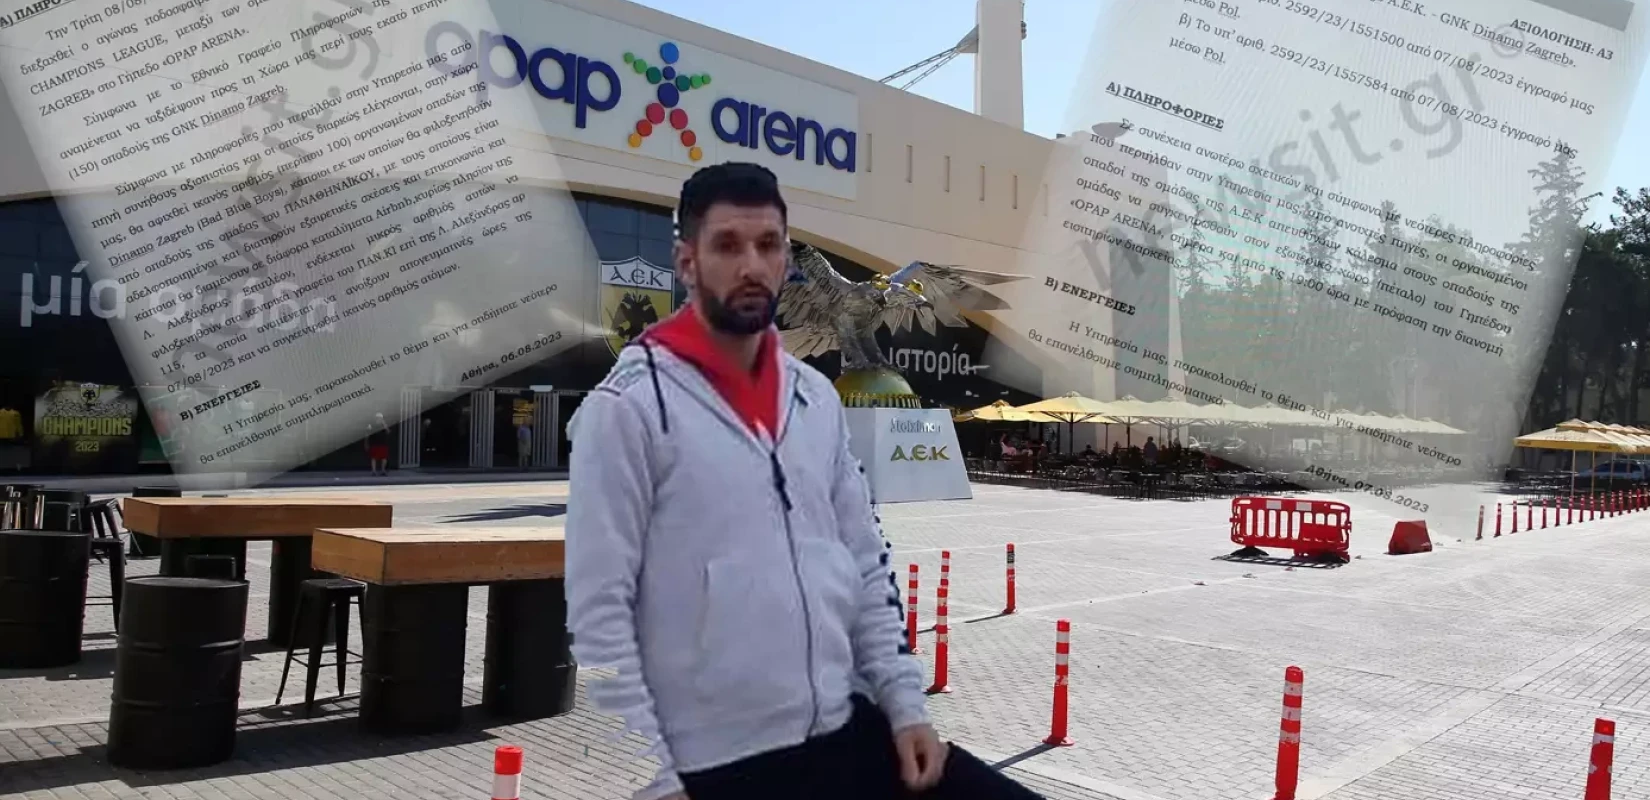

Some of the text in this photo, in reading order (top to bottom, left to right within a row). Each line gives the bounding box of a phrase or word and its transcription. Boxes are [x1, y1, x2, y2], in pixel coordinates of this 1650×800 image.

[1168, 35, 1226, 63] μέσω Pol.
[1218, 1, 1241, 17] Pol.
[1439, 12, 1470, 30] GNK
[1472, 22, 1524, 48] Dinamo
[1509, 18, 1613, 60] ΑΞΙΟΛΟΓΗΣΗ: Α3
[29, 5, 240, 95] CHAMPIONS LEAGUE, μεταξύ των
[59, 8, 408, 161] αναμένεται να ταξιδέψουν προς τη Χώρα μας περί τους εκατό
[82, 5, 364, 128] Σύμφωνα με το Εθνικό Γραφείο Πληροφοριών
[96, 79, 116, 92] στο
[116, 60, 160, 84] Γήπεδο
[1178, 12, 1192, 28] β)
[1194, 17, 1211, 32] Το
[1235, 33, 1266, 52] αριθ.
[1269, 44, 1388, 93] 2592/23/1557584
[1390, 85, 1416, 101] από
[1416, 94, 1498, 130] 07/08/2023
[1499, 121, 1552, 149] έγγραφό
[1553, 142, 1578, 159] μας
[1284, 0, 1594, 115] 2592/23/1551500 από 07/08/2023 έγγραφό μας
[68, 82, 288, 180] (150) οπαδούς της GNK Dinamo Zagreb.
[114, 39, 472, 197] Σύμφωνα με πληροφορίες που περιήλθαν στην Υπηρεσία μας από
[424, 20, 856, 172] opap arena
[1105, 80, 1224, 129] Α) ΠΛΗΡΟΦΟΡΙΕΣ
[100, 81, 487, 250] μας, θα αφιχθεί ικανός αριθμός (περίπου 100) οργανωμένων οπαδών της
[107, 98, 493, 266] Dinamo Zagreb (Bad Blue Boys), κάποιοι εκ των οποίων θα φιλοξενηθούν
[116, 117, 499, 284] από οπαδούς της ομάδας του ΠΑΝΑΘΗΝΑΪΚΟΥ, με τους οποίους είναι
[1119, 117, 1538, 272] Σε συνέχεια ανωτέρω σχετικών και σύμφωνα με νεότερες πληροφορίες
[1082, 154, 1520, 315] οπαδοί της ομάδας της Α.Ε.Κ κάλεσμα στους οπαδούς της
[20, 261, 126, 327] μία
[1043, 275, 1136, 315] Β) ΕΝΕΡΓΕΙΕΣ
[1325, 284, 1351, 303] ώρα
[1353, 296, 1370, 309] με
[1372, 301, 1428, 331] πρόφαση
[1431, 323, 1452, 337] την
[1453, 328, 1504, 357] διανομή
[459, 330, 562, 382] Αθήνα, 06.08.2023
[1068, 321, 1080, 333] Η
[1084, 325, 1138, 355] Υπηρεσία
[1141, 348, 1168, 366] μας,
[1172, 358, 1257, 396] παρακολουθεί
[1260, 389, 1273, 400] το
[1416, 443, 1462, 467] νεότερο
[43, 416, 132, 436] CHAMPIONS
[178, 378, 261, 421] Β) ΕΝΕΡΓΕΙΕΣ
[75, 441, 99, 452] 2023
[1303, 463, 1429, 513] Αθήνα, 07.08.2023
